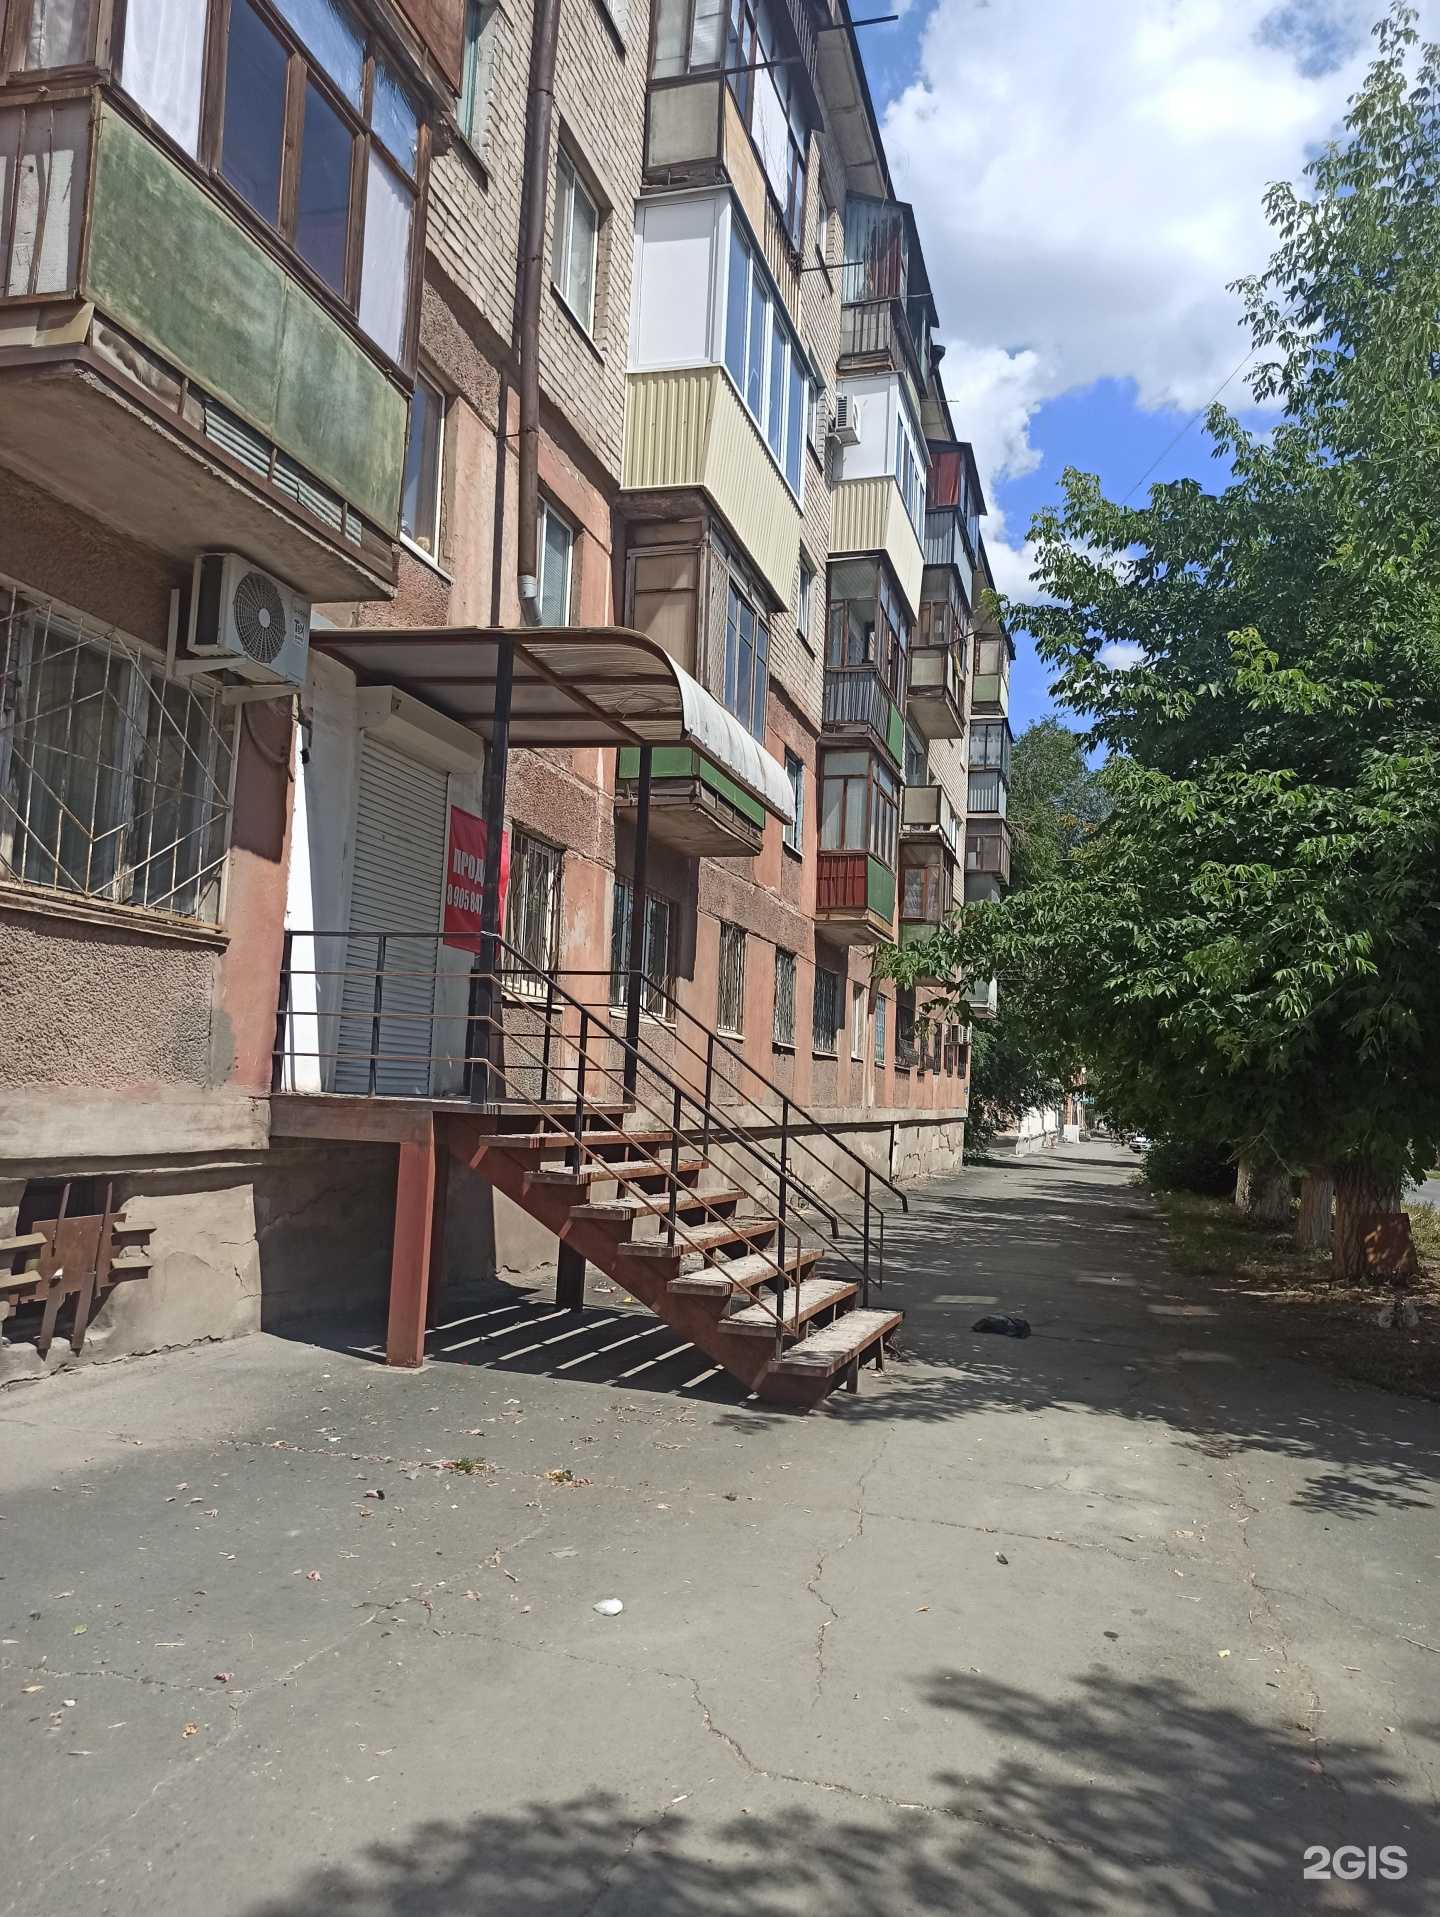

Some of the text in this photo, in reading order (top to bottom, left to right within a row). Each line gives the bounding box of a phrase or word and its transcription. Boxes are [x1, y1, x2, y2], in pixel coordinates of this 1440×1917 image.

[453, 848, 486, 887] ПРОД
[447, 884, 453, 905] 8
[454, 887, 469, 910] 905
